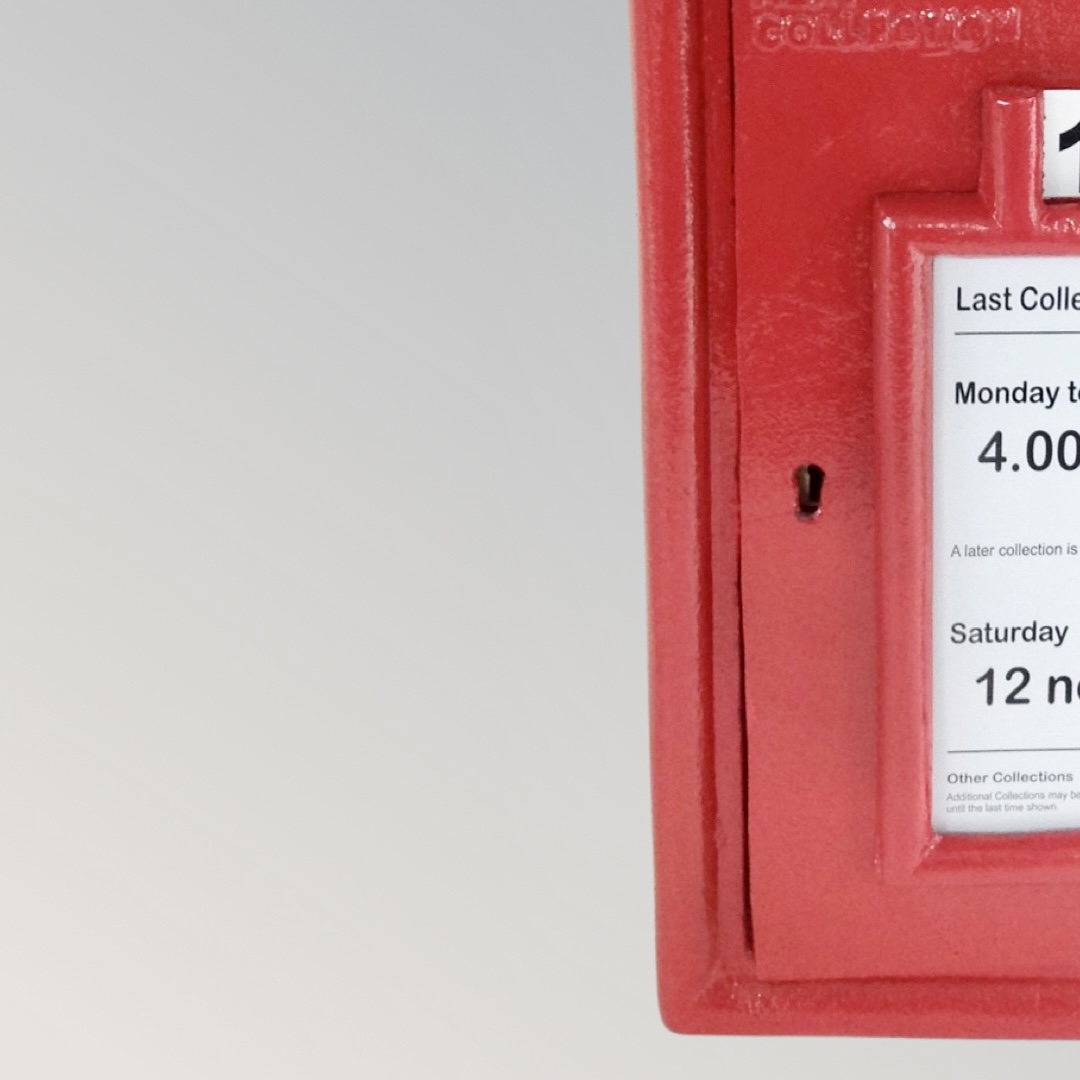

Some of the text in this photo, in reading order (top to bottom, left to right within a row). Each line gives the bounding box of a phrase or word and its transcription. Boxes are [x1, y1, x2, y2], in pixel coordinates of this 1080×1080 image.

[956, 286, 1013, 312] Last
[955, 380, 1060, 410] Monday
[950, 544, 962, 558] A
[964, 544, 995, 558] later
[998, 543, 1063, 557] collection
[1066, 542, 1079, 556] is
[950, 620, 1069, 648] Saturday
[975, 666, 1031, 706] 12
[946, 771, 1074, 784] Other Collections
[1048, 791, 1067, 801] may
[968, 803, 982, 812] the
